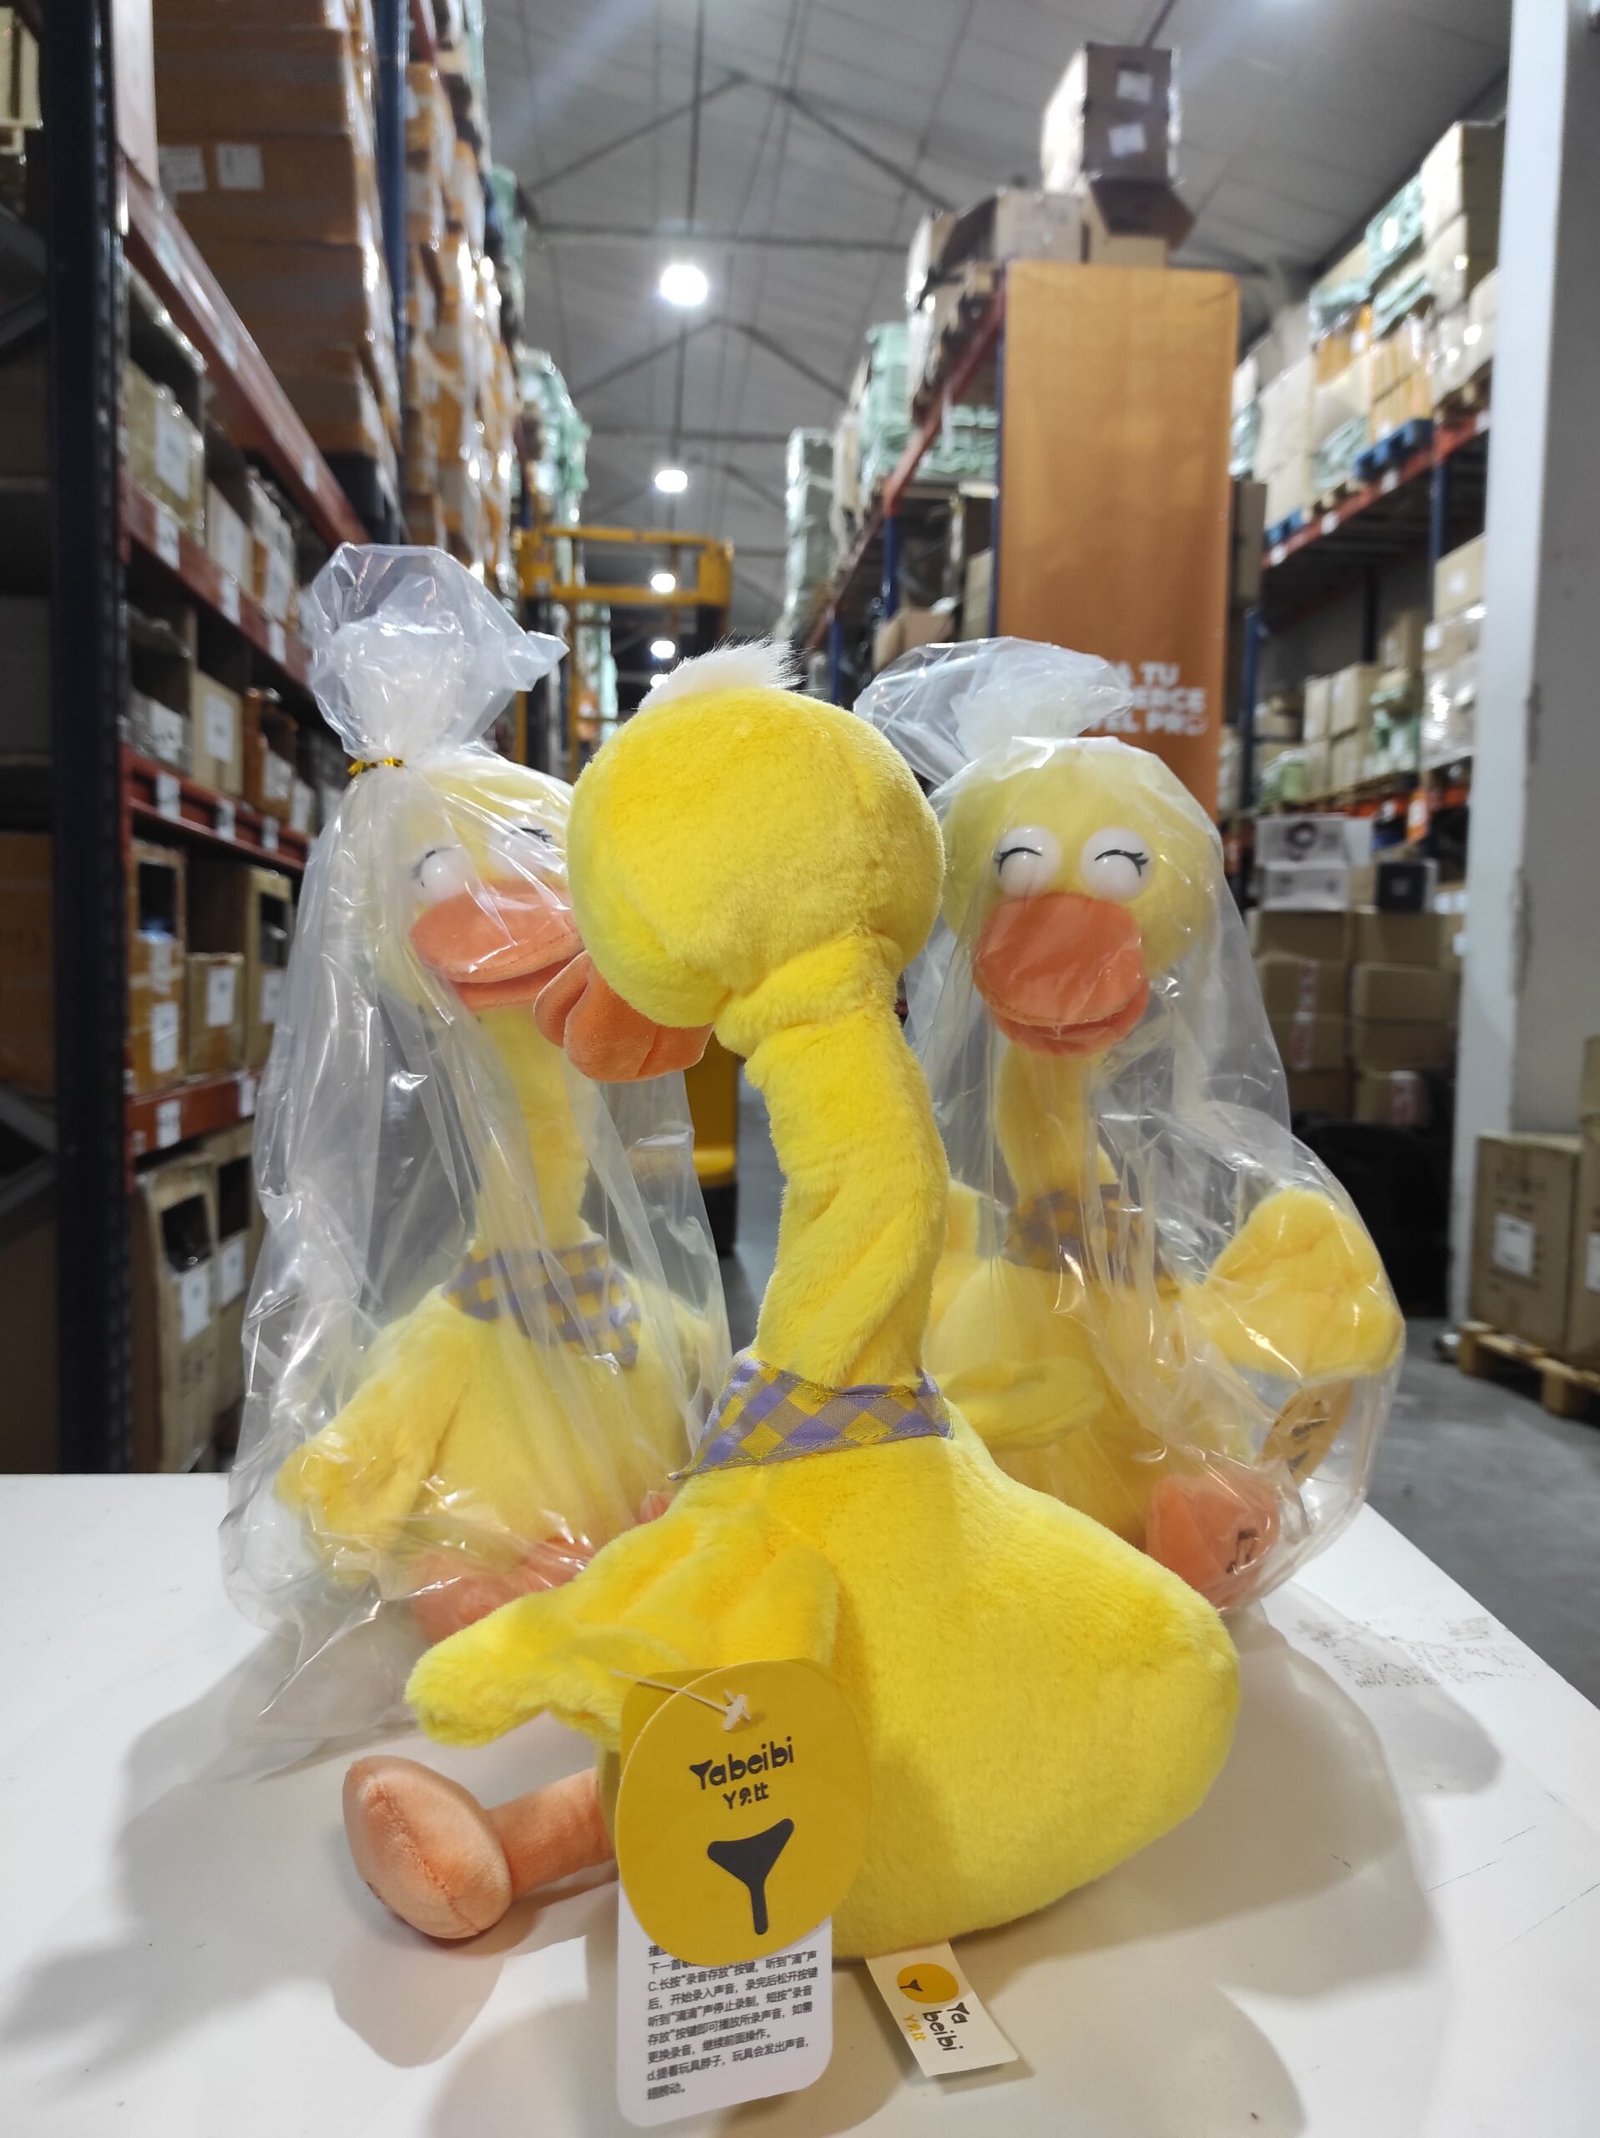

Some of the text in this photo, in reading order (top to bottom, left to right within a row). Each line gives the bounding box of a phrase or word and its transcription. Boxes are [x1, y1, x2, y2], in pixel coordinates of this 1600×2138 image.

[1139, 661, 1180, 687] TU
[1132, 686, 1206, 712] ERCE
[689, 1735, 795, 1790] Yabeibi
[946, 2001, 971, 2024] Ya
[922, 2010, 964, 2051] beibi
